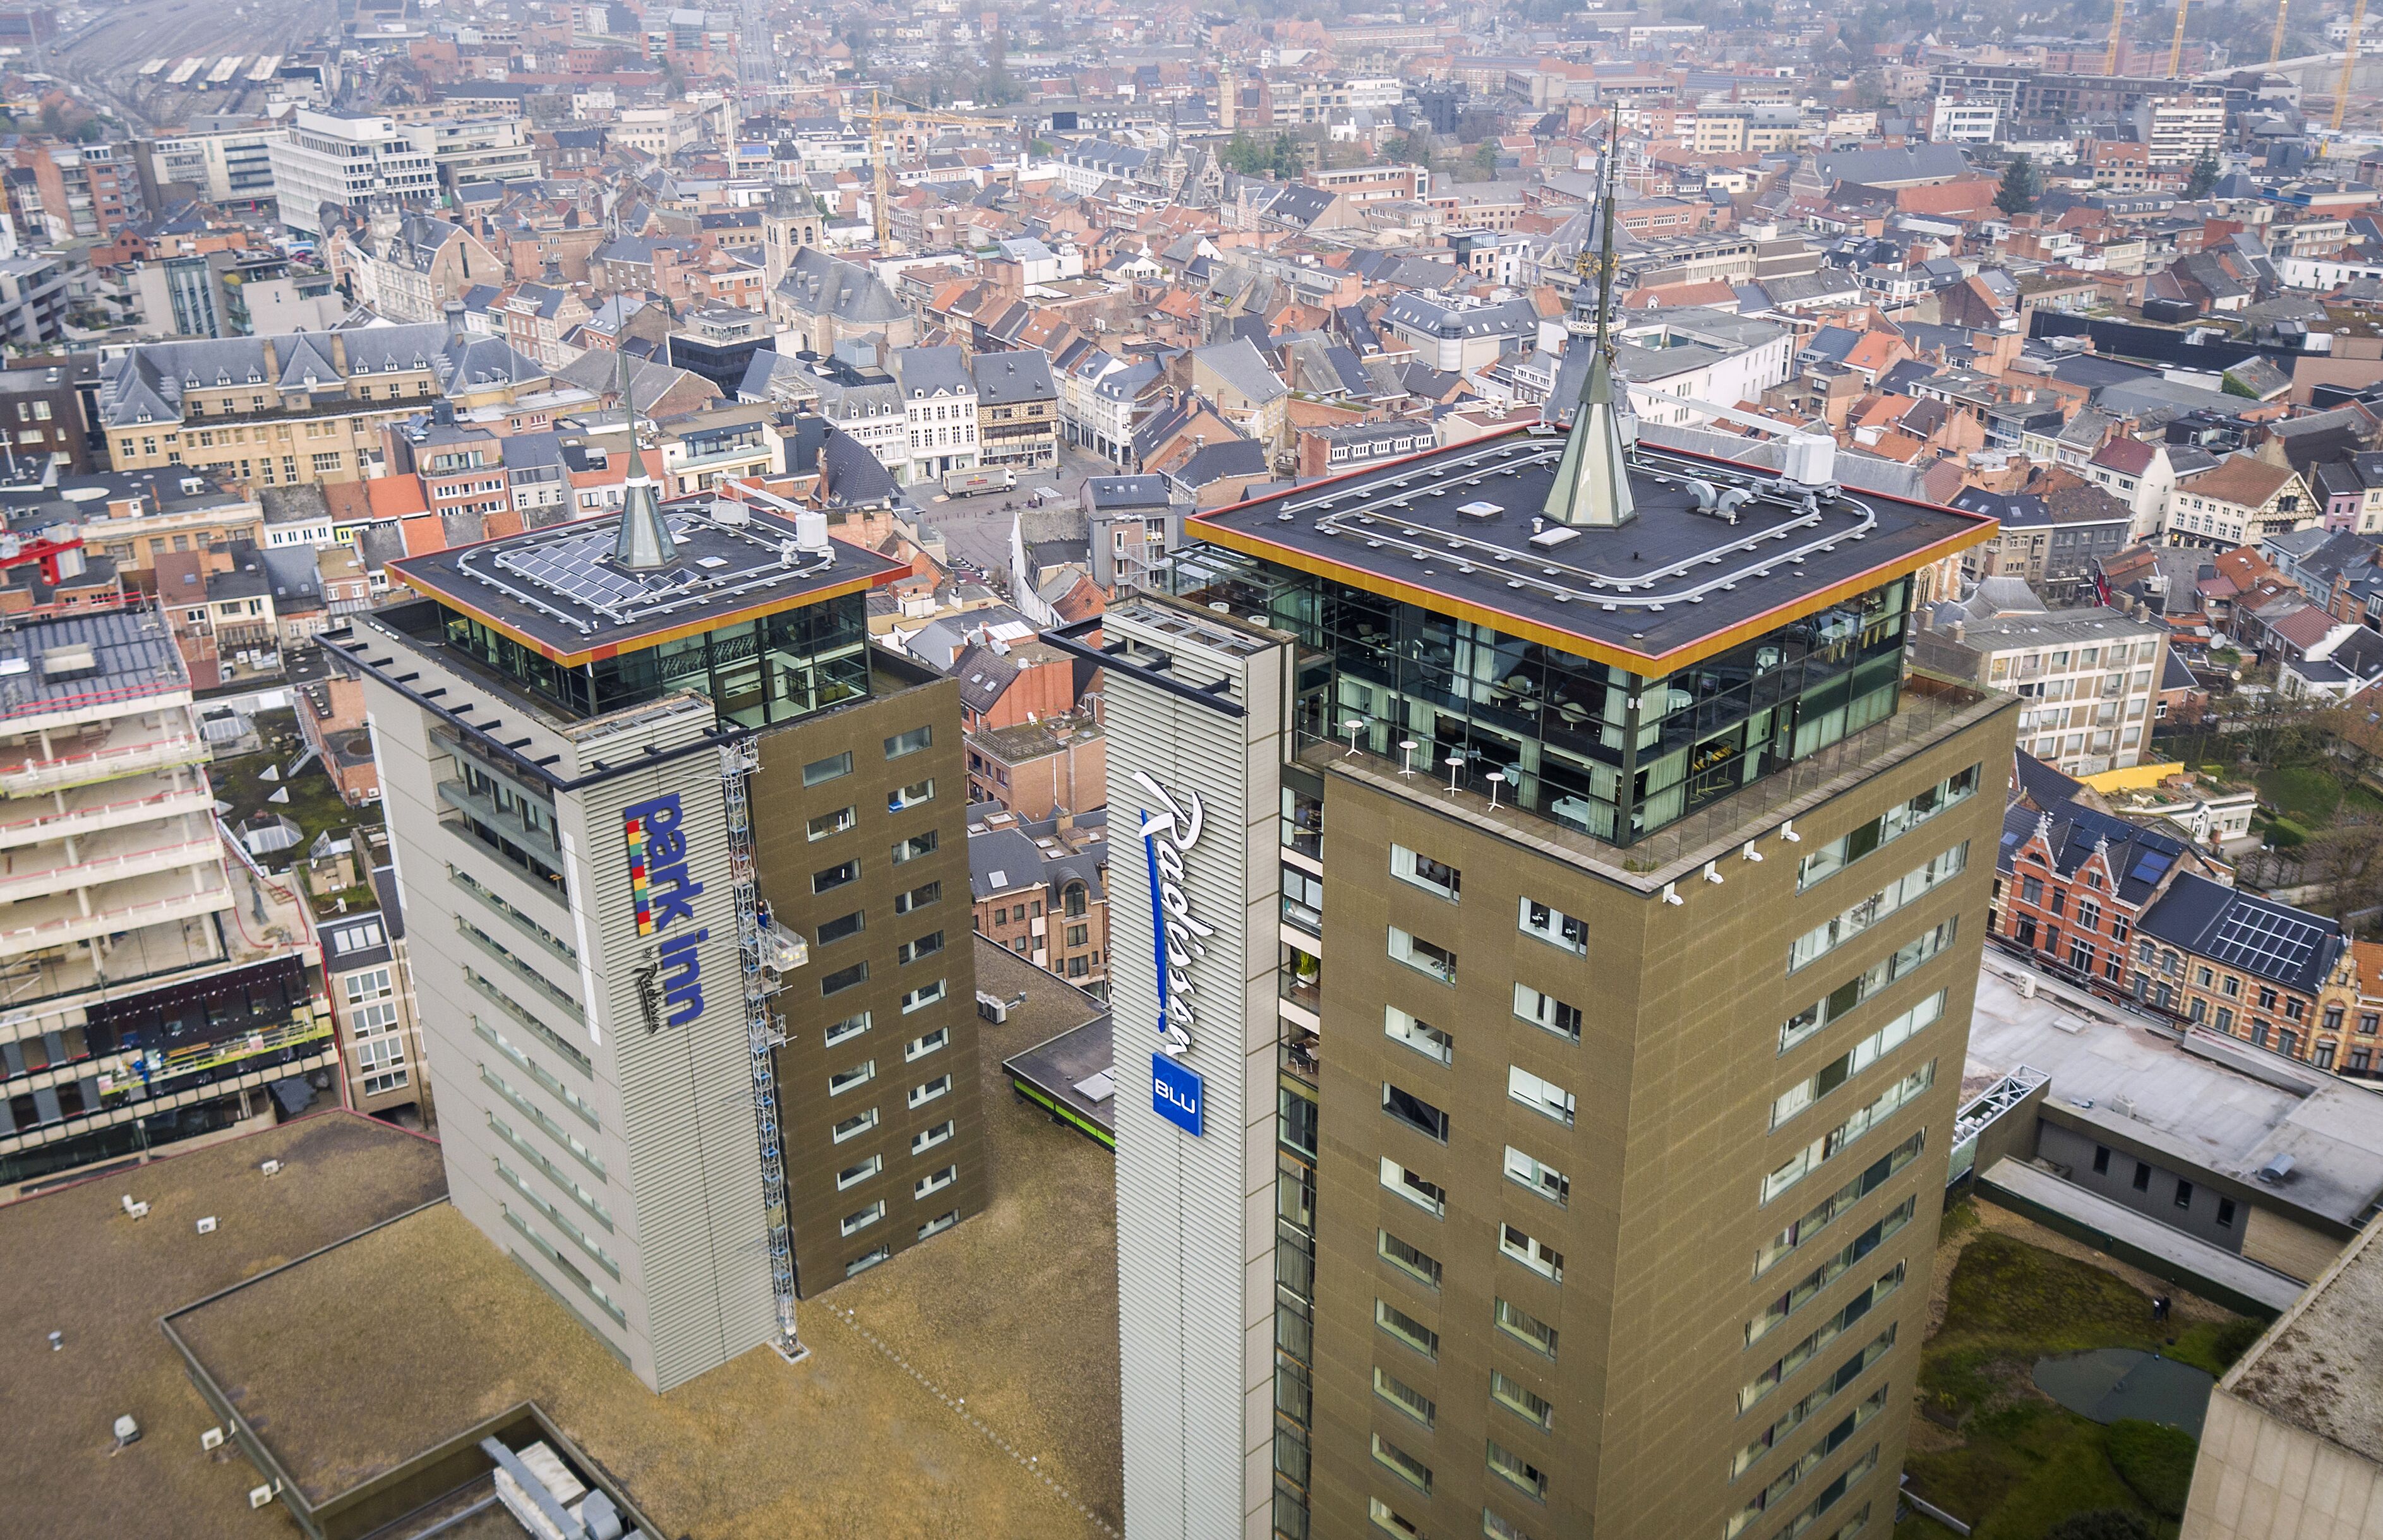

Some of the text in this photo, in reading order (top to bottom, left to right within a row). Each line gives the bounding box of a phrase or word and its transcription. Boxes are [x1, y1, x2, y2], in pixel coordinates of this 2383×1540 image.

[625, 792, 709, 1027] park inn
[1131, 771, 1215, 1056] Radisson
[633, 947, 663, 1034] by Radisson
[1155, 1078, 1196, 1114] BLU
